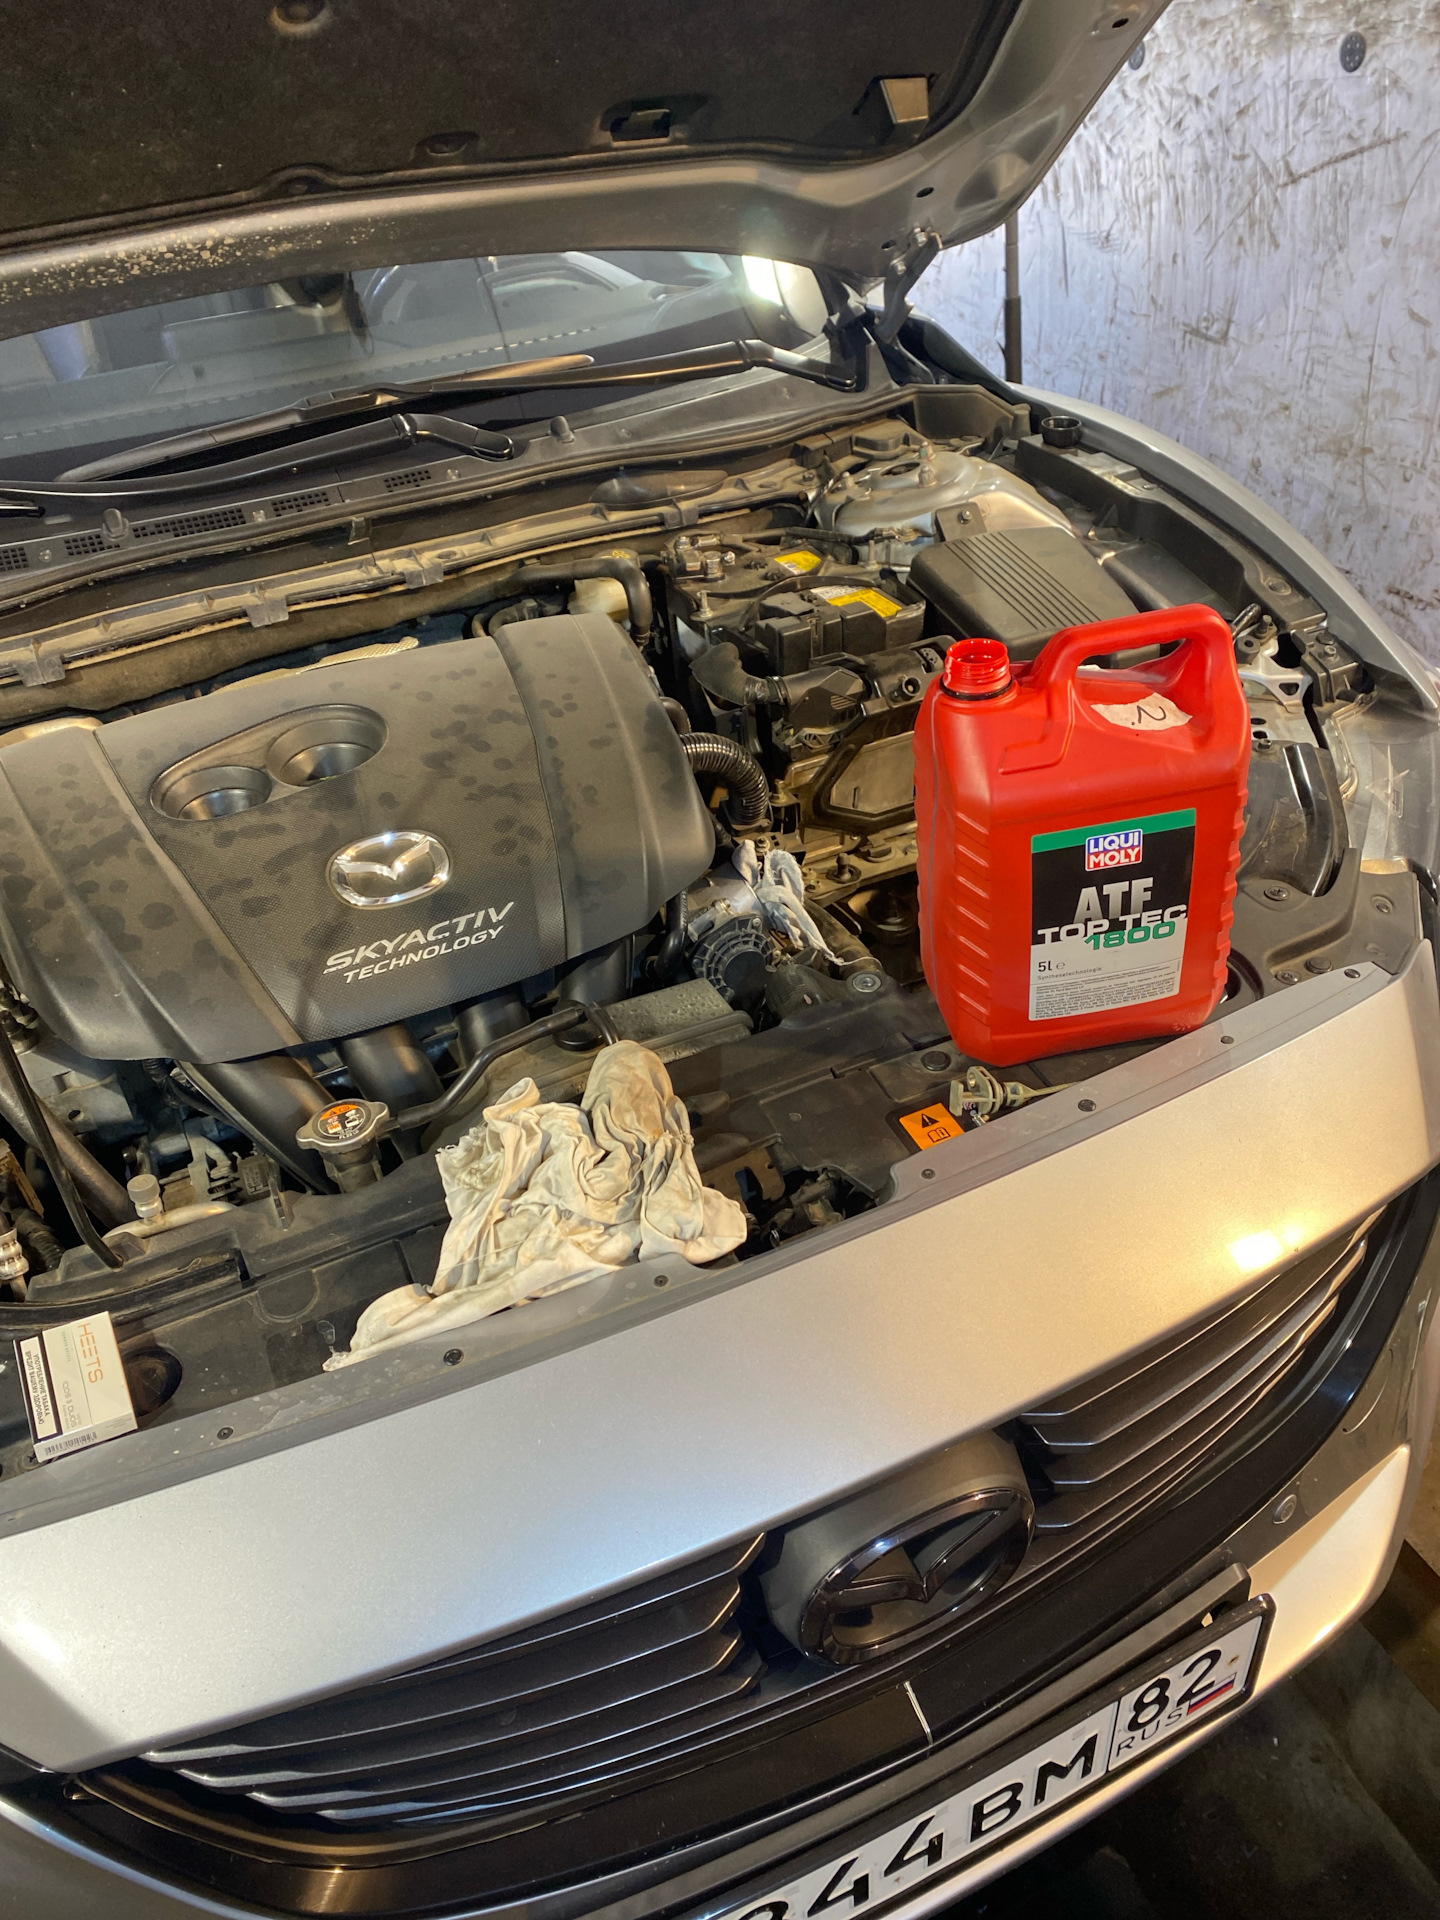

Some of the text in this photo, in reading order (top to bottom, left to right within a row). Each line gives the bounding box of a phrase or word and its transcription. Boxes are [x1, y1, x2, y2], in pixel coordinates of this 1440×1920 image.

[1089, 831, 1140, 853] LIQUI
[1089, 847, 1141, 869] MOLY
[1037, 904, 1188, 946] TOP TEC
[1073, 877, 1154, 925] ATF
[322, 901, 515, 975] SKYACTIV
[343, 925, 505, 984] TECHNOLOGY
[1085, 921, 1176, 950] 1800
[77, 1322, 104, 1384] HEETS
[24, 1350, 45, 1425] ВРЕДИТ ВАШЕМУ ЗДОРОВЬЮ
[34, 1353, 51, 1417] УПОТРЕБЛЕНИЕ ТАБАКА
[1129, 1649, 1222, 1732] 82
[1117, 1706, 1187, 1758] RUS
